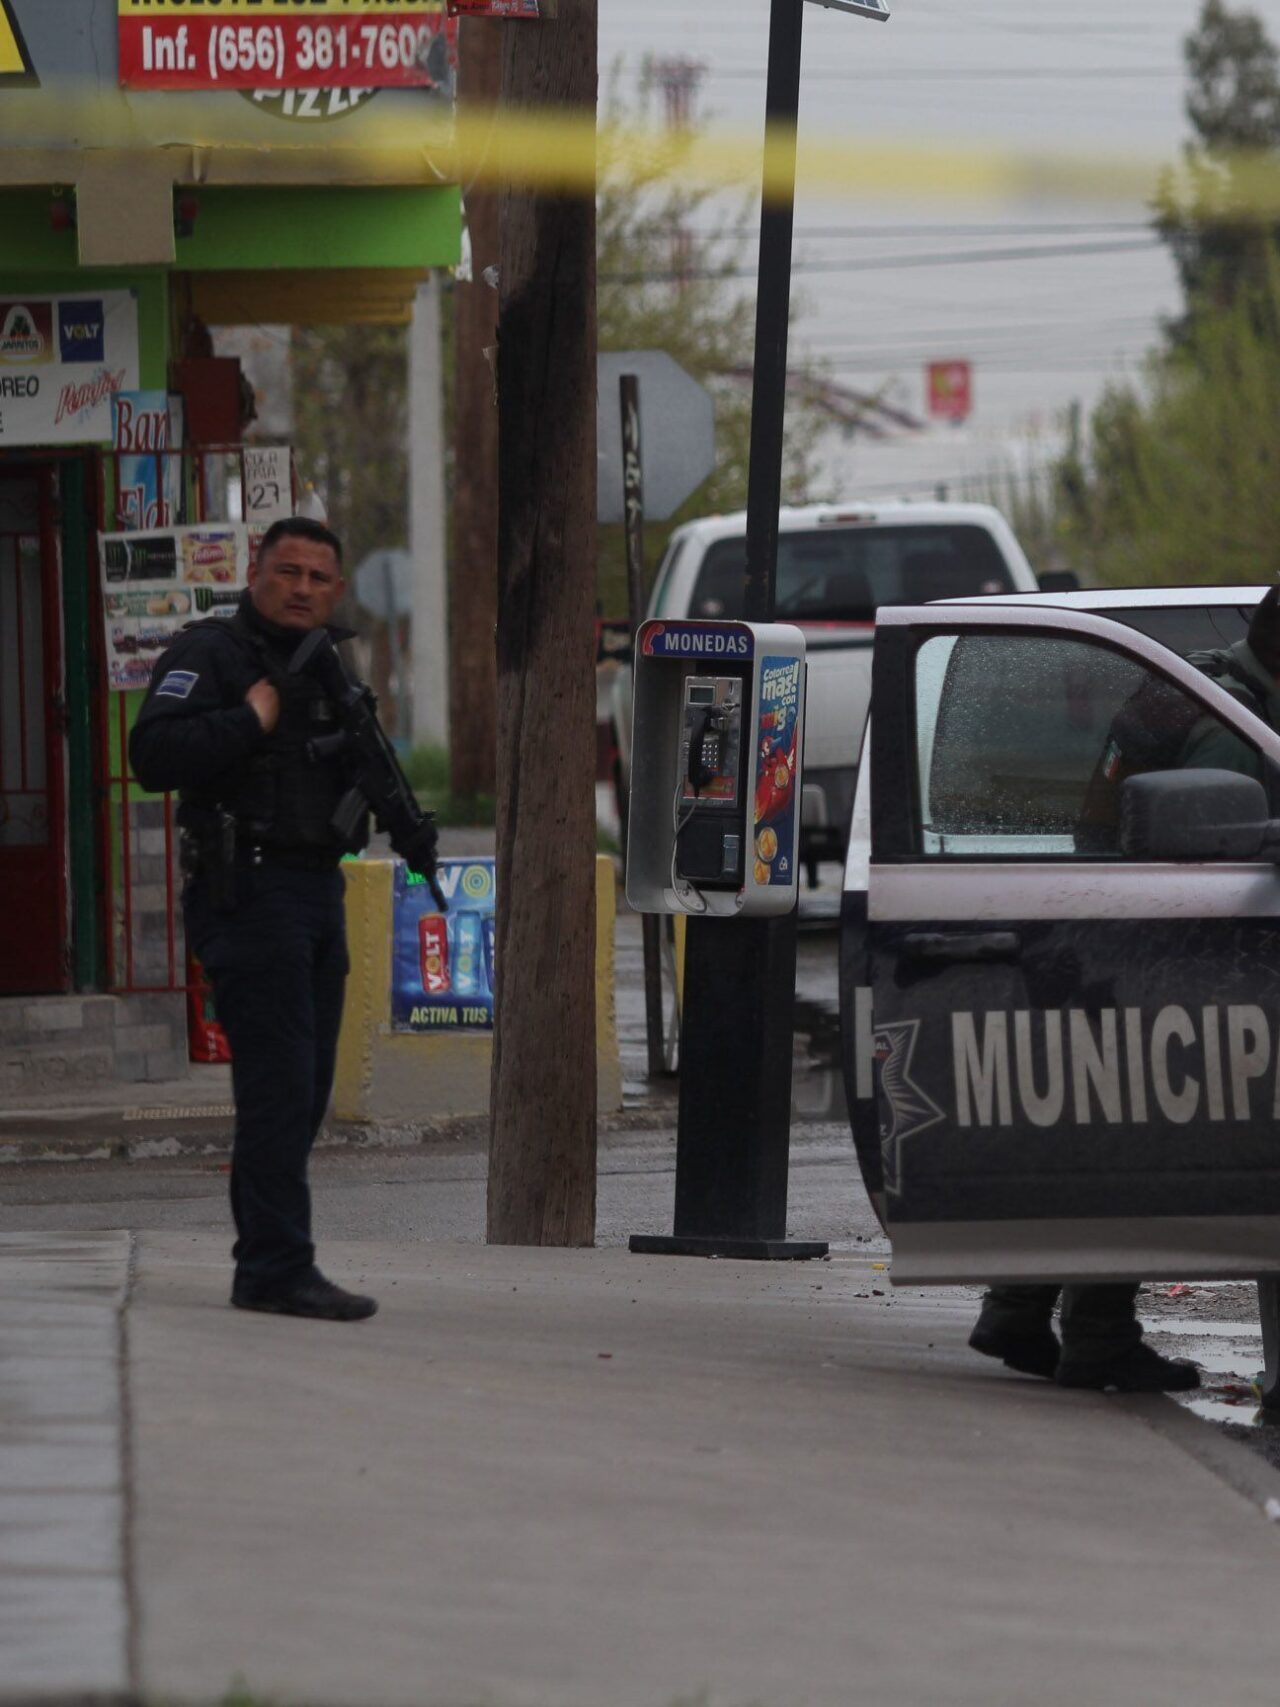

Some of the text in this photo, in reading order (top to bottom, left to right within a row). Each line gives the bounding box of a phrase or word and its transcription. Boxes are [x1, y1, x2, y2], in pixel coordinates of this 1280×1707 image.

[142, 24, 196, 71] Inf.
[208, 25, 285, 80] (656)
[63, 323, 99, 341] VOLT
[0, 375, 39, 399] REO
[665, 632, 748, 653] MONEDAS
[781, 694, 796, 706] con
[437, 865, 495, 898] VO
[424, 931, 444, 990] VOLT
[456, 931, 474, 989] VOLT
[410, 1006, 488, 1025] ACTIVA TUS
